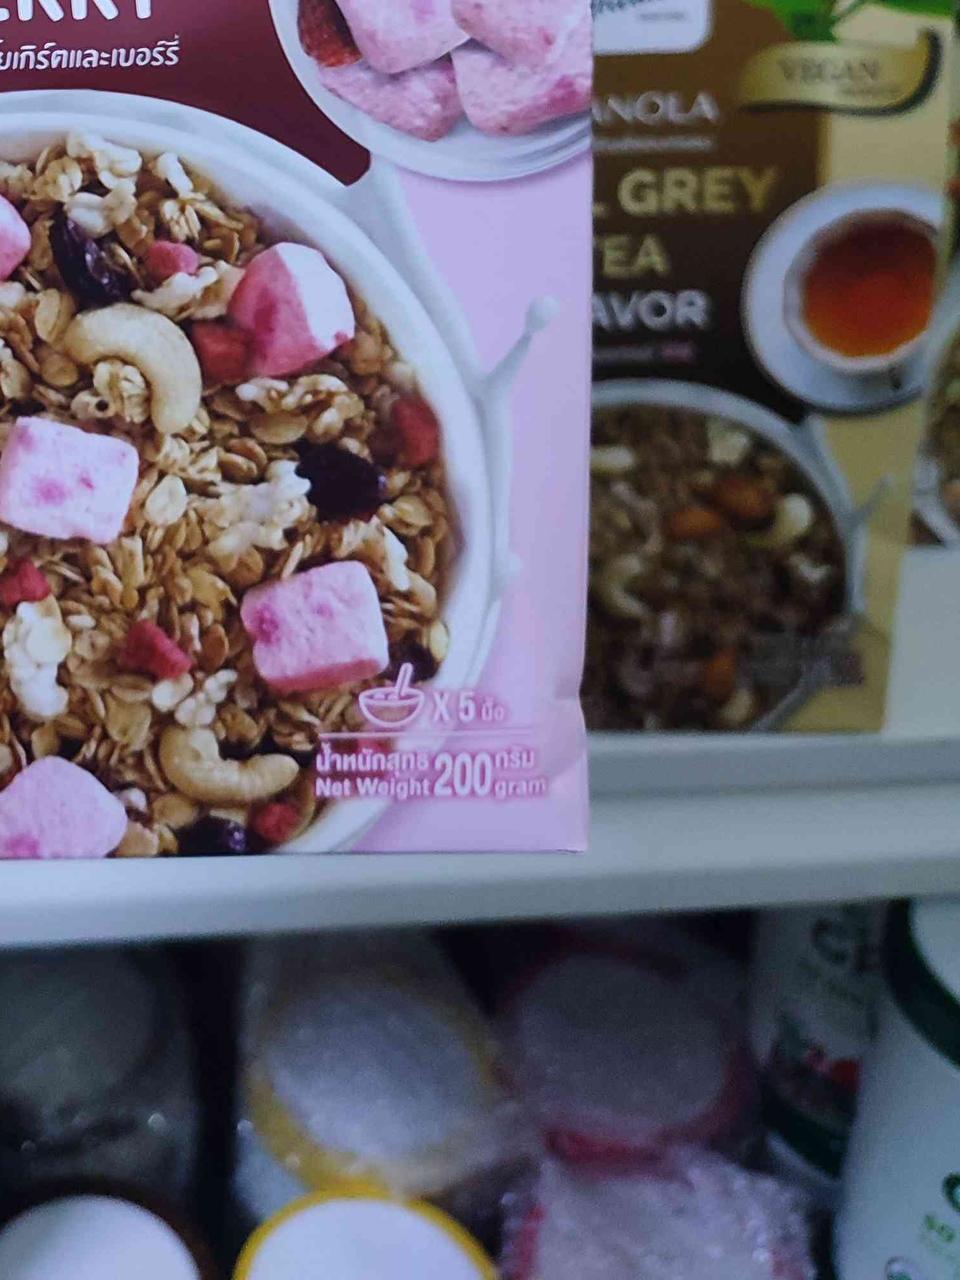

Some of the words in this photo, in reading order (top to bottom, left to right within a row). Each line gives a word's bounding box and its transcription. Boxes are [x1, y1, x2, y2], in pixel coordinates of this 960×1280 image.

[617, 166, 778, 218] GREY
[593, 233, 671, 277] EA
[458, 690, 476, 722] 5
[316, 778, 351, 797] Net
[356, 777, 431, 800] Weight
[495, 779, 547, 800] gram
[434, 751, 492, 797] 200
